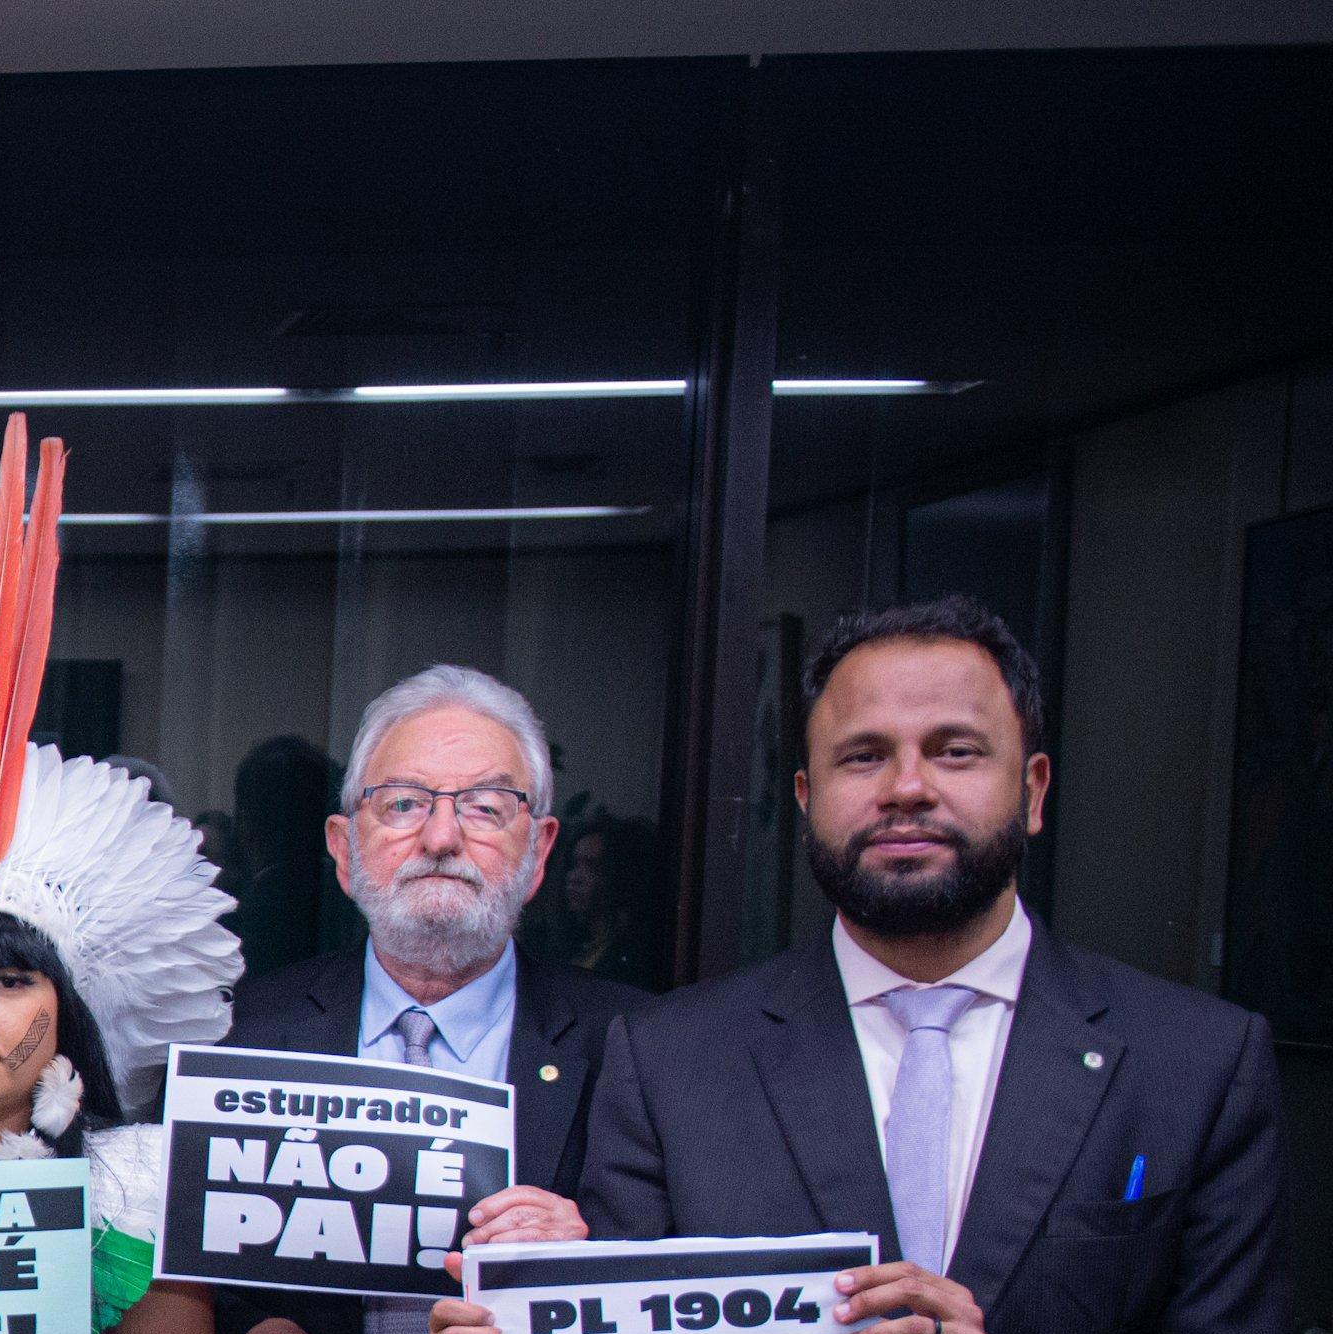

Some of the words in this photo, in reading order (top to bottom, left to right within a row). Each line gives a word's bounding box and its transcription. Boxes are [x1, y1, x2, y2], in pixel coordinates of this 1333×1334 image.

[213, 1086, 468, 1129] estuprador
[207, 1128, 388, 1192] NÃO
[414, 1139, 464, 1199] É
[202, 1193, 460, 1270] PAI!
[640, 1287, 821, 1332] 1904
